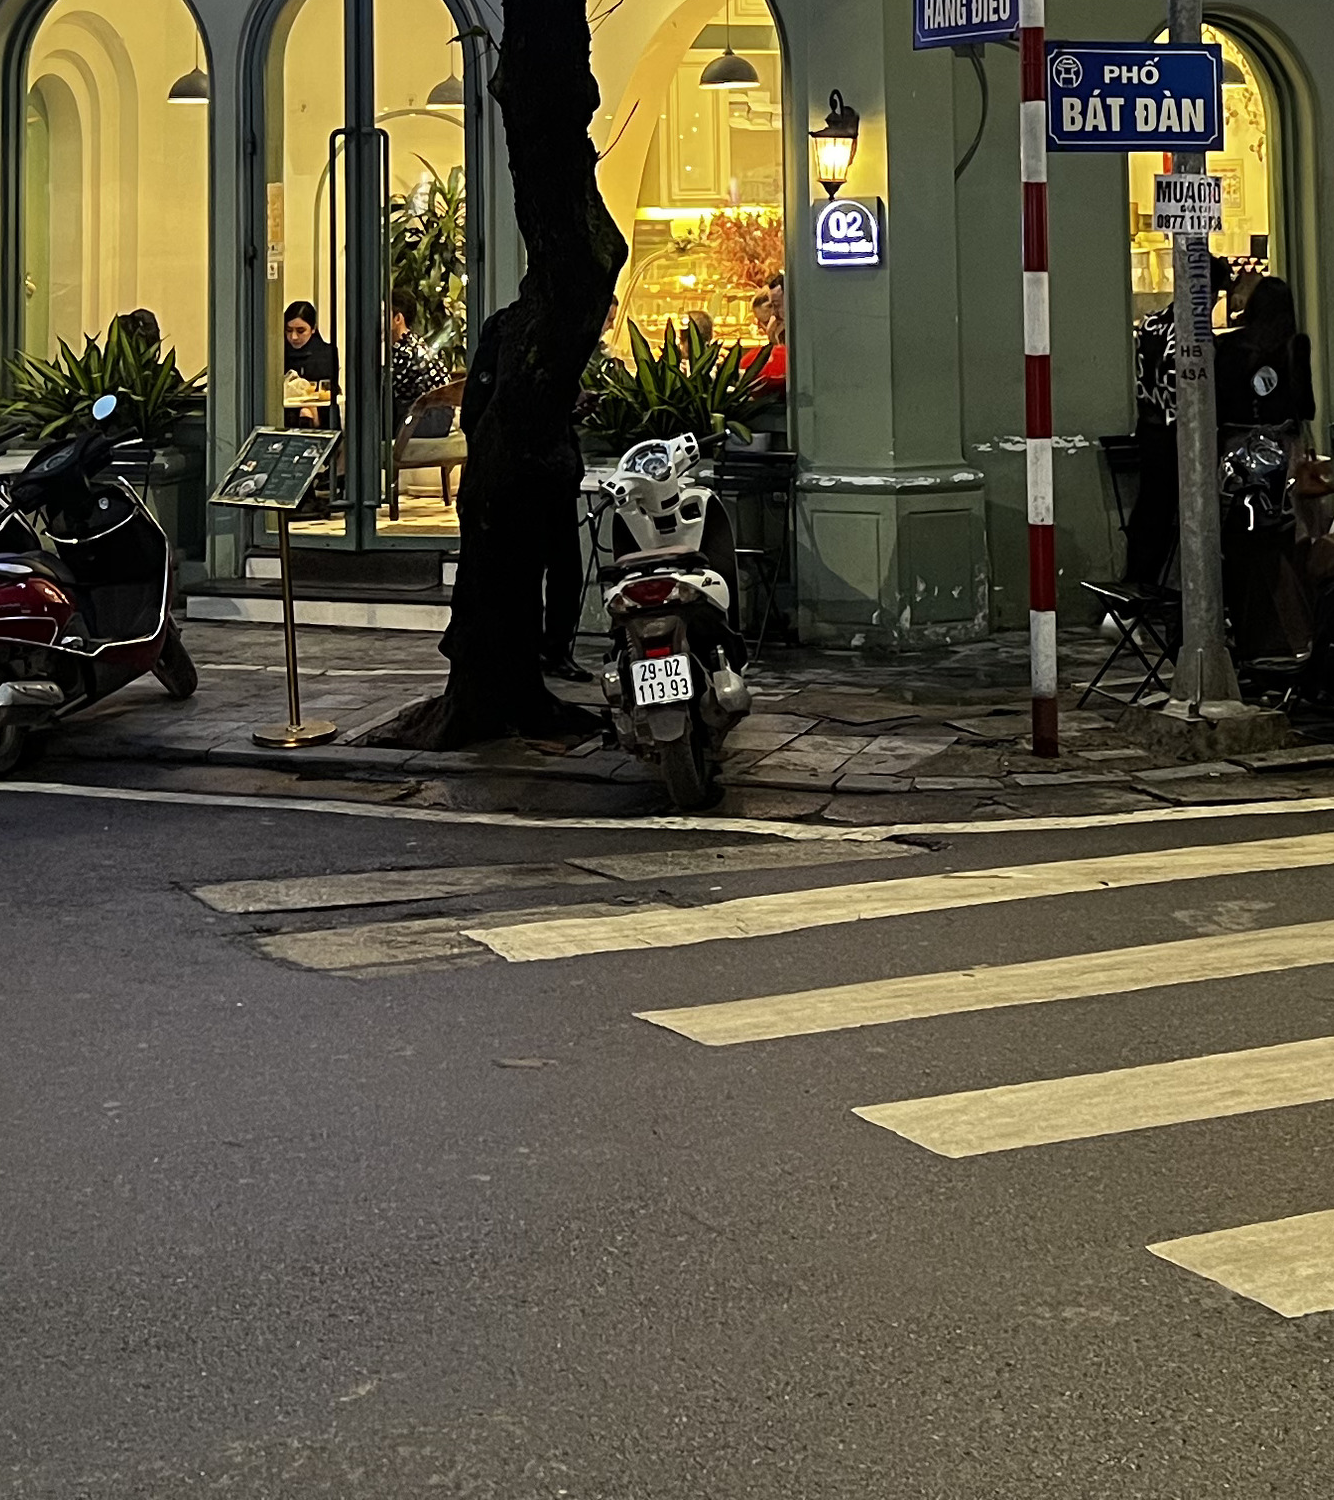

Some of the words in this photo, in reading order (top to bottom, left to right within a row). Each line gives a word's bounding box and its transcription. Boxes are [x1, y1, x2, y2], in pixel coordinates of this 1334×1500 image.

[1104, 56, 1160, 85] PHỐ
[1062, 89, 1125, 132] BÁT
[1135, 90, 1205, 132] ĐÀN
[829, 211, 864, 239] 02
[1181, 346, 1202, 358] HB
[1181, 368, 1208, 381] 43A
[639, 659, 681, 682] 29-D2
[638, 678, 690, 703] 113.93
